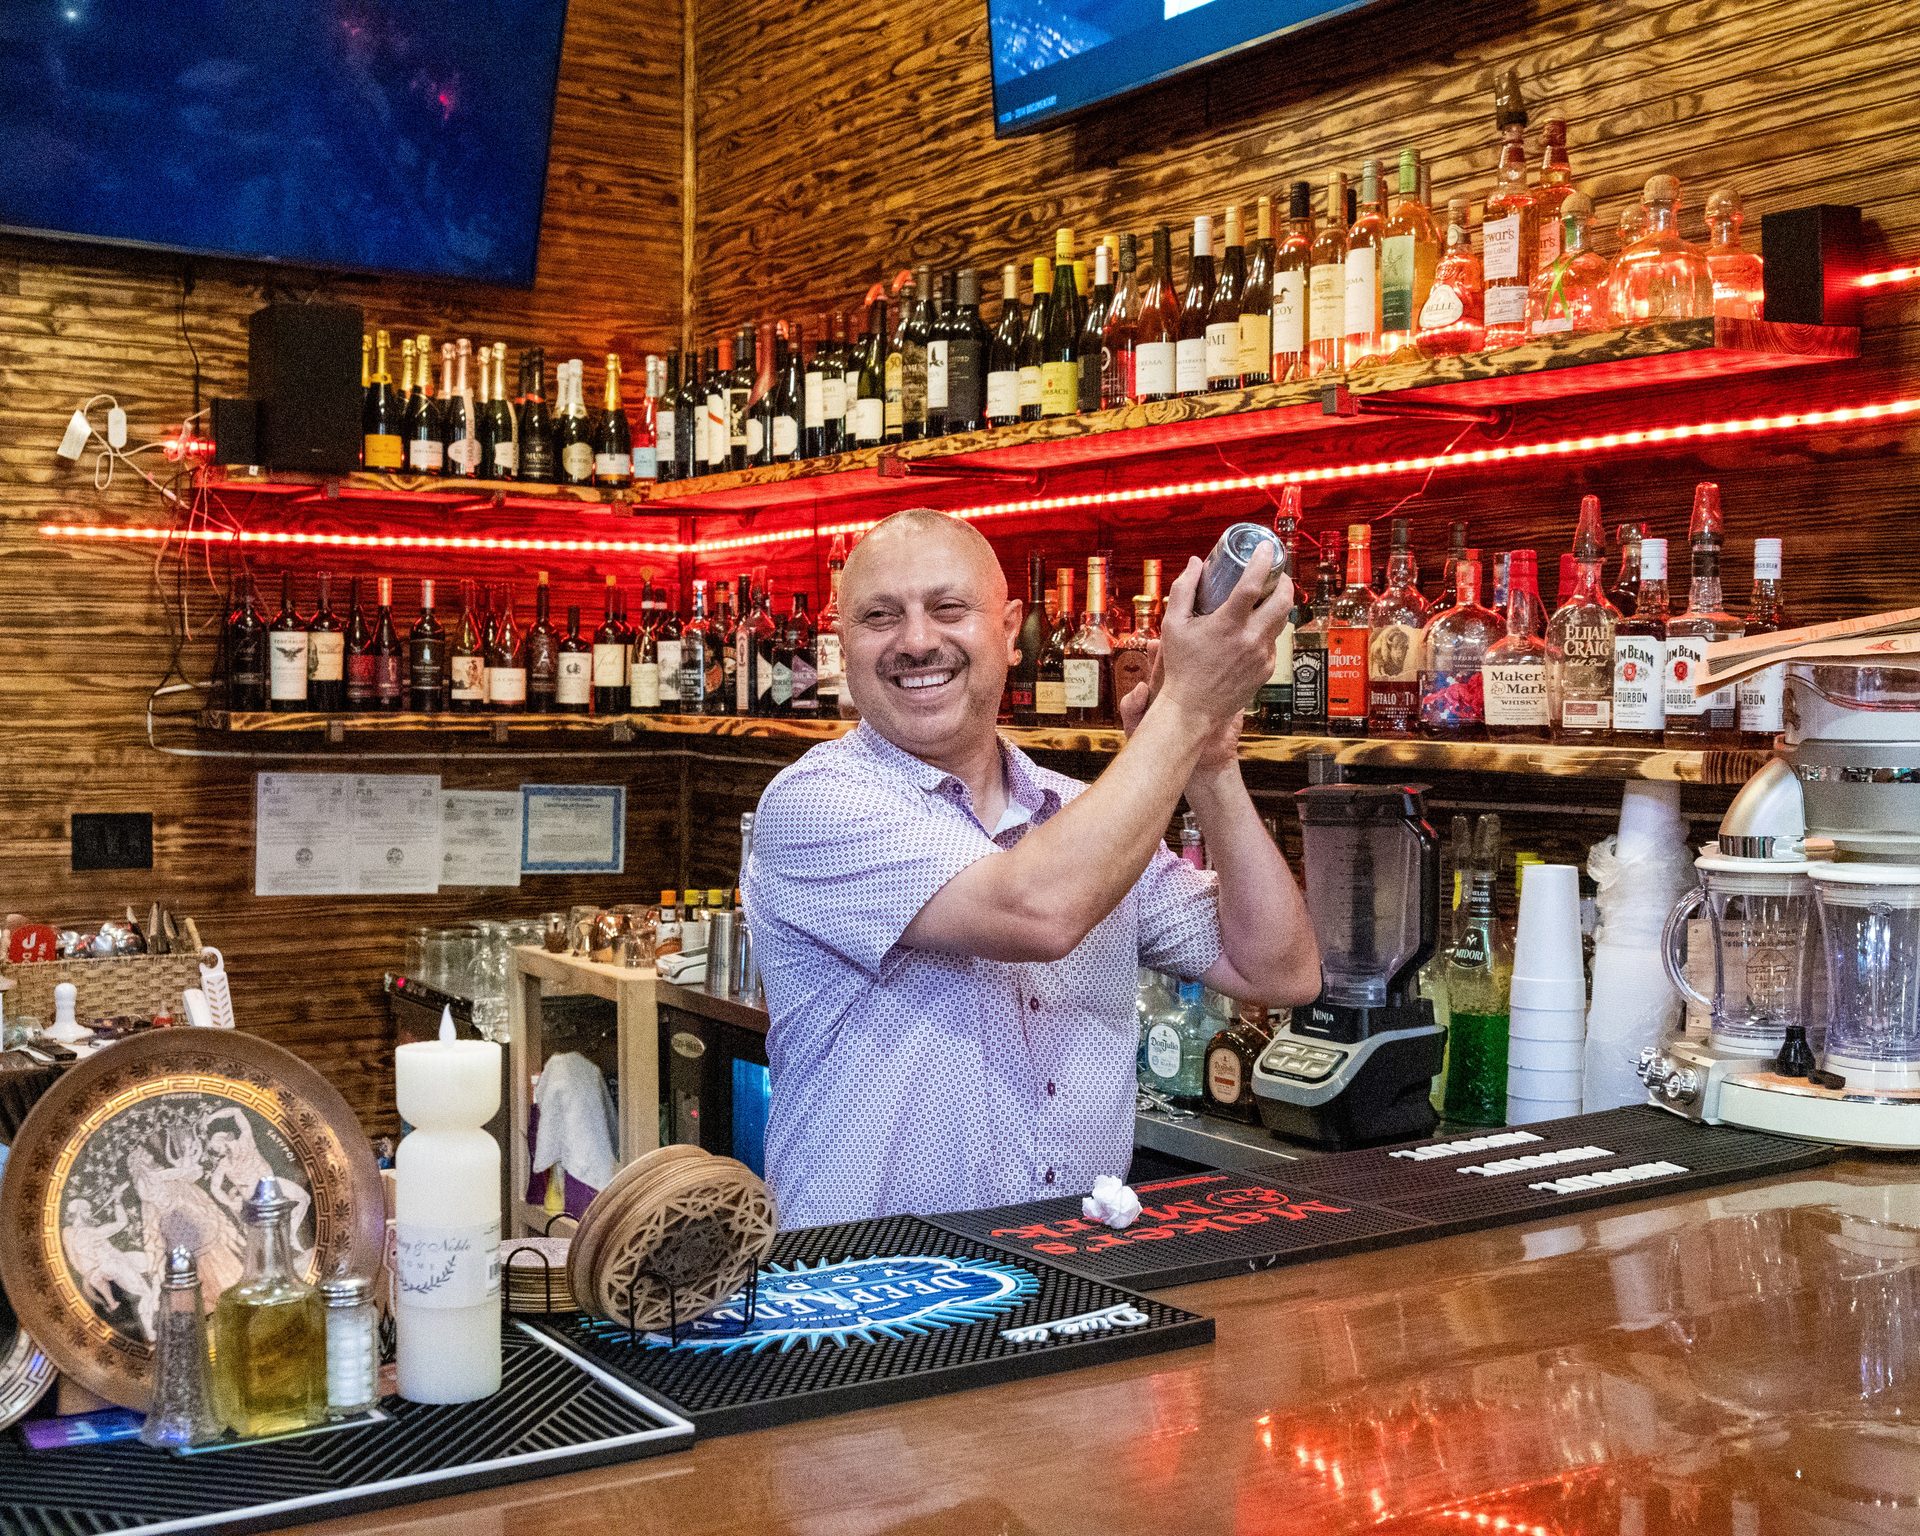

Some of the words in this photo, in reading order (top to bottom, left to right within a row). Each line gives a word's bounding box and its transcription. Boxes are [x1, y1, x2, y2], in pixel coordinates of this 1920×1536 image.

[1564, 623, 1610, 641] ELIJAH
[1564, 640, 1610, 658] CRAIG
[1628, 644, 1654, 667] BEAM
[1679, 645, 1701, 662] BEAM
[1329, 655, 1361, 667] more
[1506, 683, 1547, 695] Mark
[1615, 692, 1648, 703] BOURBON
[1742, 694, 1766, 705] RBON
[1456, 949, 1484, 960] MIDORI
[1313, 1008, 1334, 1024] NINJA
[1151, 1036, 1164, 1049] Don
[1162, 1039, 1179, 1051] Julio
[990, 1199, 1223, 1240] Mrk
[1032, 1200, 1351, 1255] Maker's
[852, 1275, 971, 1304] DEEP
[1055, 1307, 1151, 1337] Dive
[998, 1328, 1052, 1344] in
